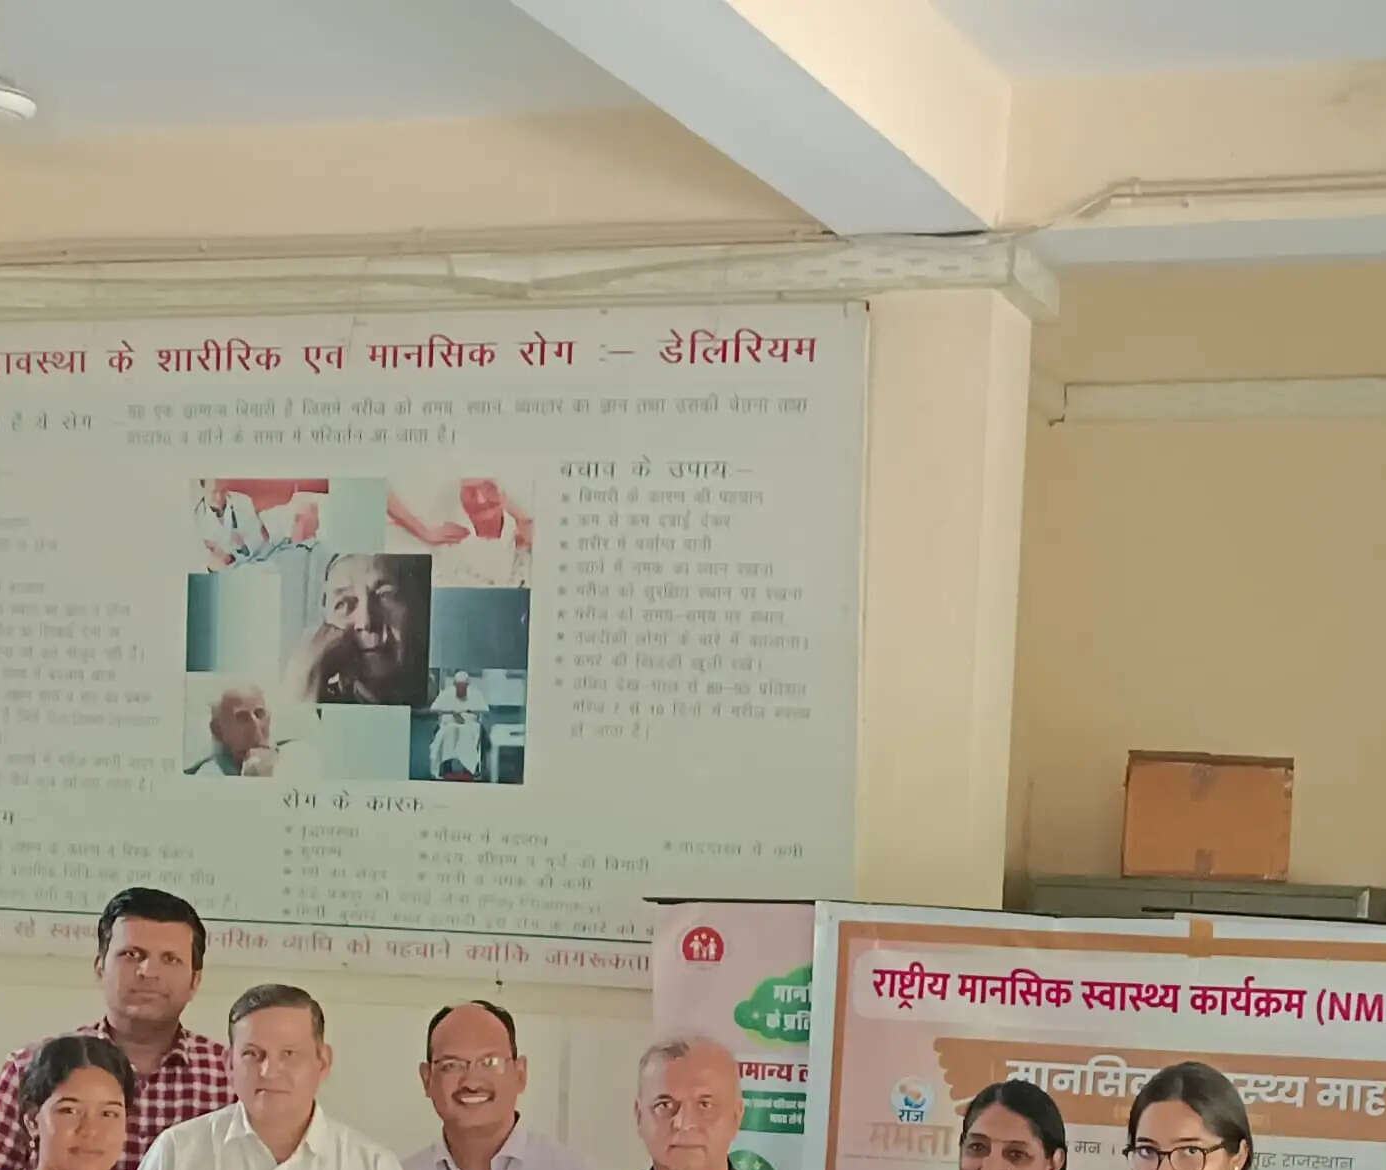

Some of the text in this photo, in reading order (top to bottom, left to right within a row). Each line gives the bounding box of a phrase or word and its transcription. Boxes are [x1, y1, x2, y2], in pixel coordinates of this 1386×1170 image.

[108, 341, 134, 374] के
[156, 339, 282, 372] शारीरिक
[365, 334, 497, 369] मानसिक
[513, 331, 578, 367] रोग
[659, 328, 817, 366] डेलिरियम
[282, 788, 317, 809] रोग
[333, 790, 350, 811] के
[872, 960, 951, 1010] राष्ट्रीय
[958, 968, 1073, 1009] मानसिक
[1081, 980, 1182, 1014] स्वास्थ्य
[1189, 975, 1308, 1020] कार्यक्रम
[898, 1108, 925, 1123] राज
[1073, 1140, 1102, 1155] मन
